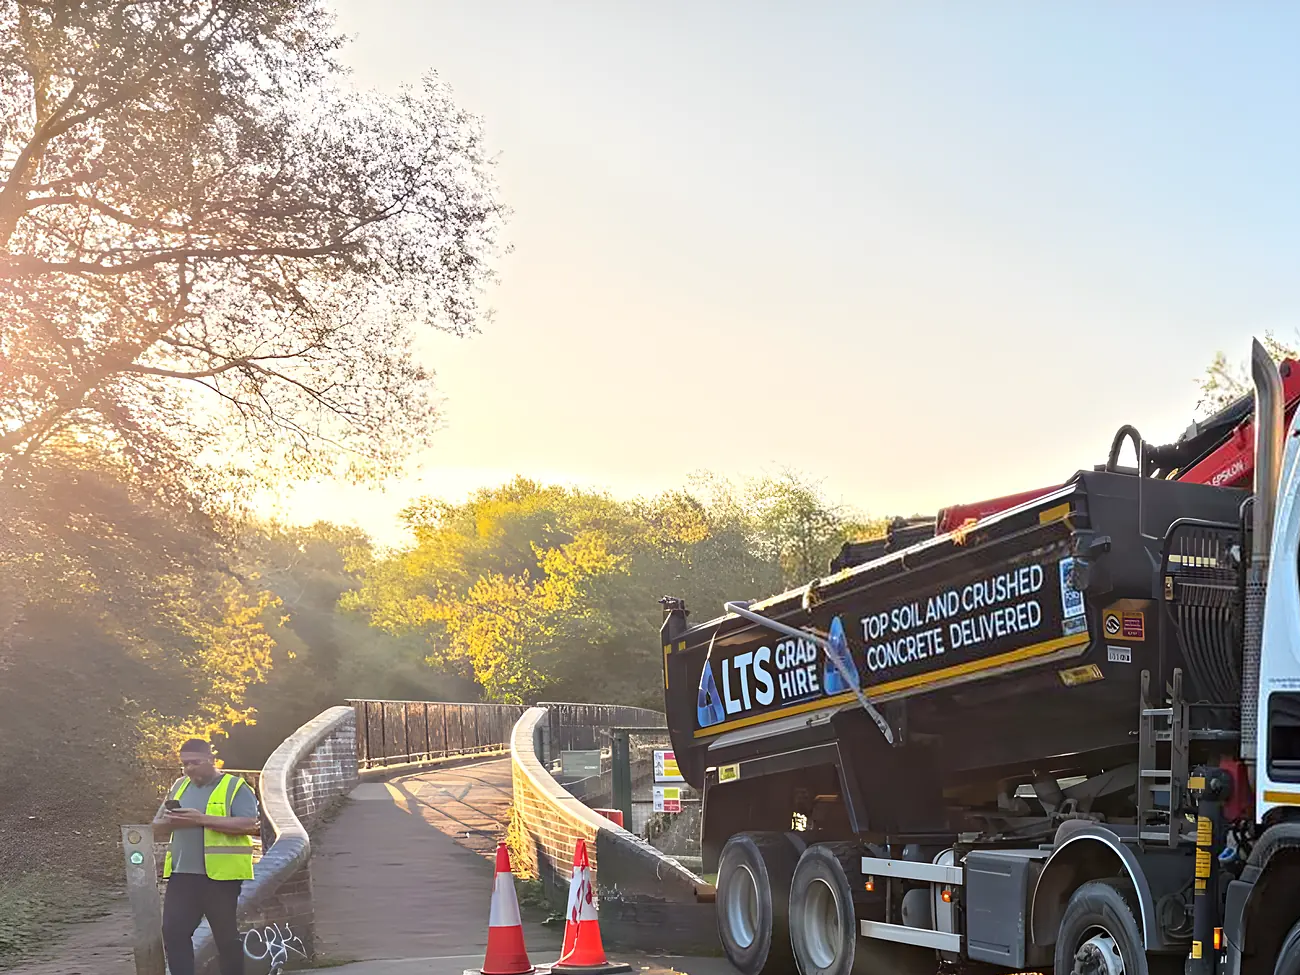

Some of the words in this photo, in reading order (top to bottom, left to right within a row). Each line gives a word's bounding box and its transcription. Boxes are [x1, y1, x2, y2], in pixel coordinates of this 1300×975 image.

[860, 612, 890, 642] TOP
[891, 602, 924, 633] SOIL
[925, 591, 960, 624] AND
[962, 564, 1044, 611] CRUSHED
[775, 638, 818, 670] GRAB
[866, 628, 945, 671] CONCRETE
[950, 600, 1042, 649] DELIVERED
[778, 664, 820, 700] HIRE
